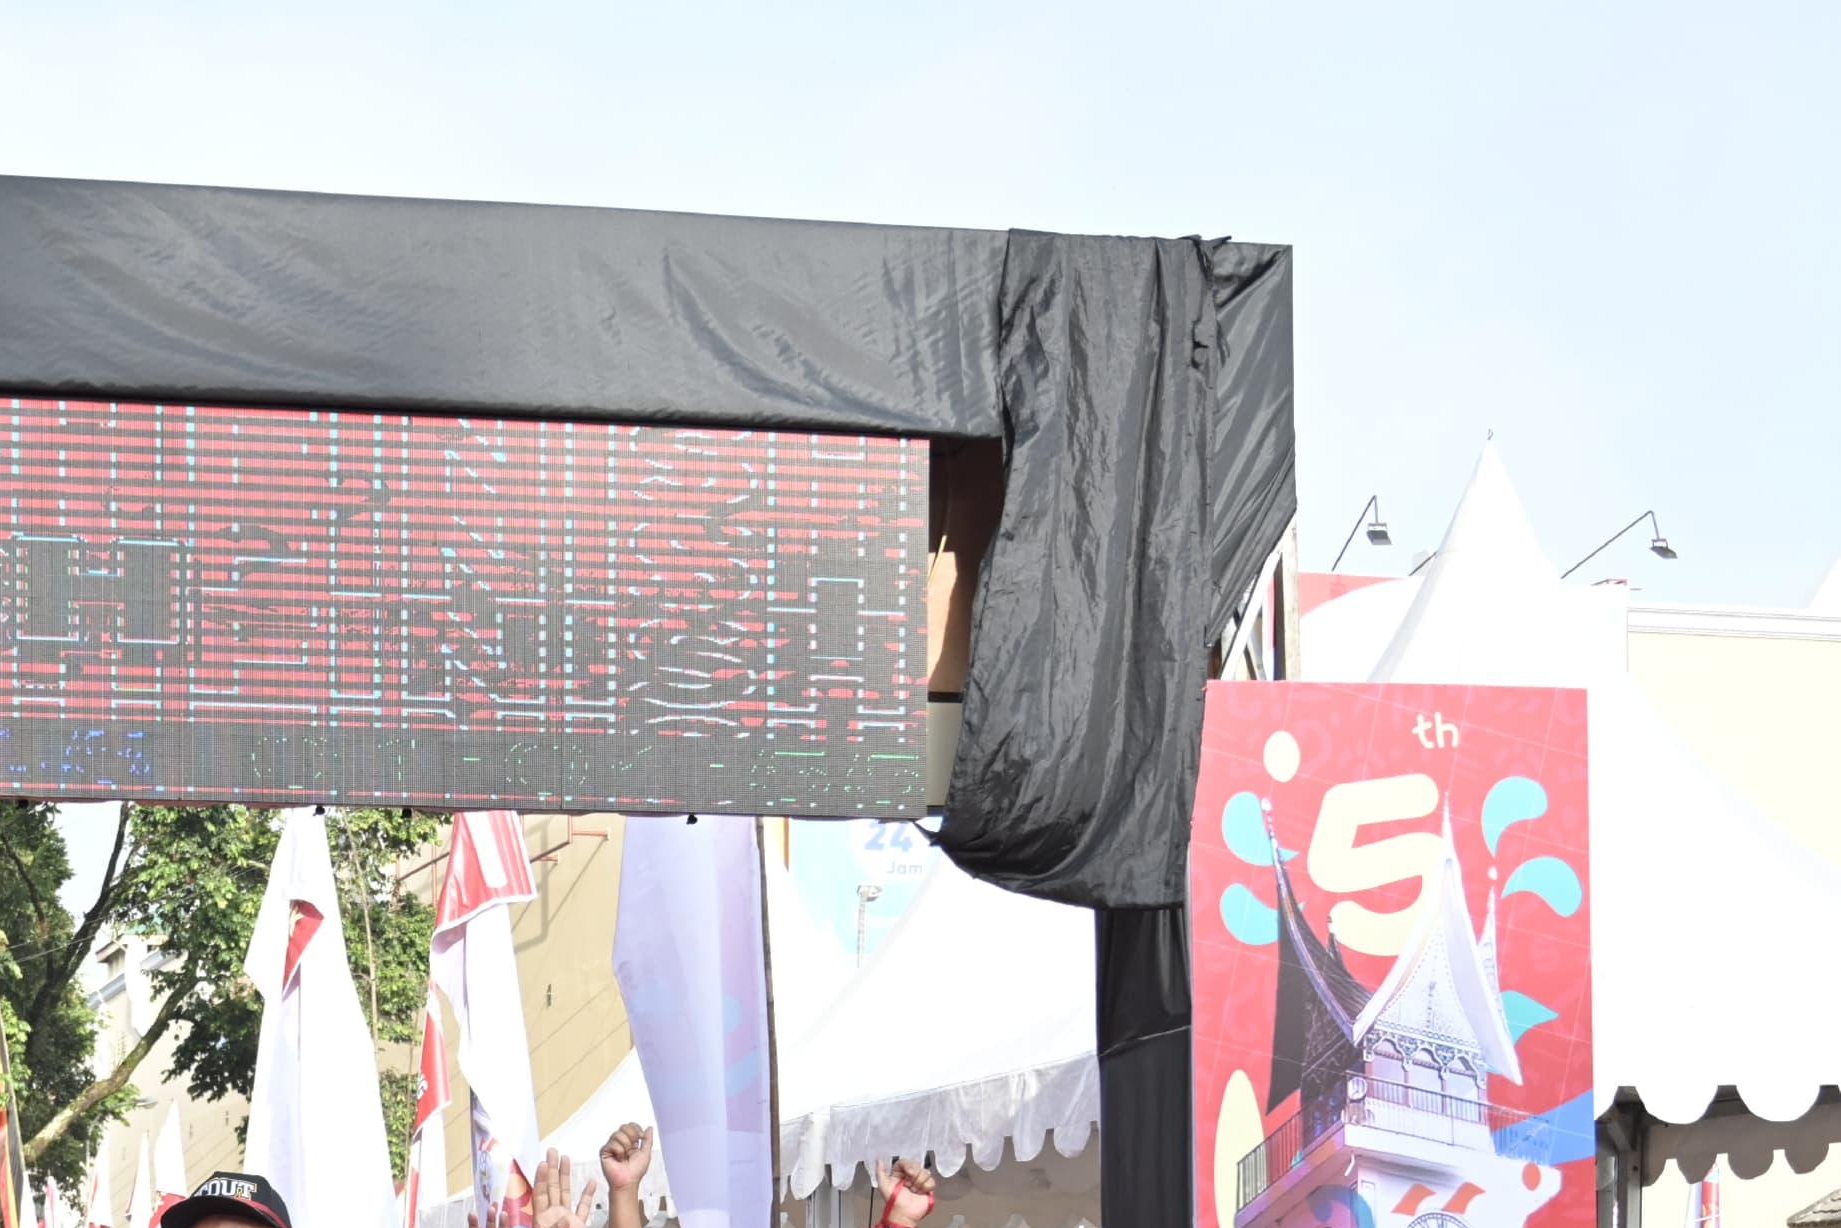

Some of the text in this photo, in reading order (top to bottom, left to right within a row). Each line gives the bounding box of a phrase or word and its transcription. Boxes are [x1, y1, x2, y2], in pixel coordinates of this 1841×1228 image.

[1411, 712, 1459, 748] th
[864, 820, 912, 852] 24
[1306, 773, 1446, 957] 5
